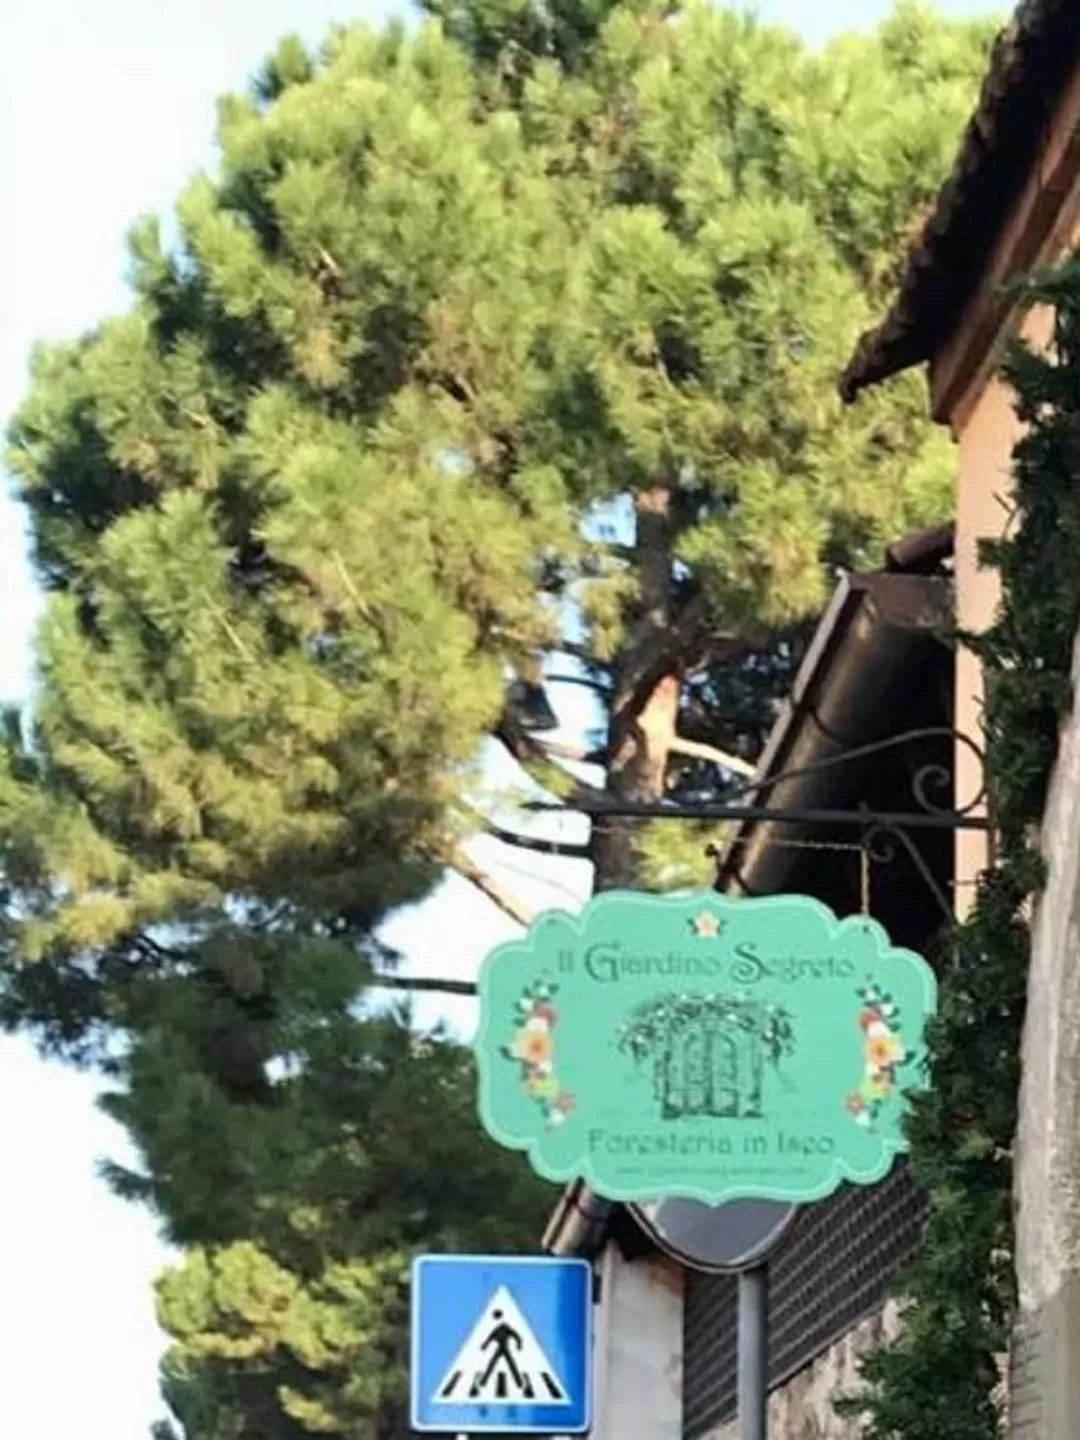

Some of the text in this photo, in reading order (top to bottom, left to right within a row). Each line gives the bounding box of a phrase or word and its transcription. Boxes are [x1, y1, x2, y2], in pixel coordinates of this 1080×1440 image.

[583, 941, 721, 984] Giardino
[732, 942, 856, 985] Segreto
[588, 1129, 732, 1155] Foresteria
[743, 1133, 768, 1155] in
